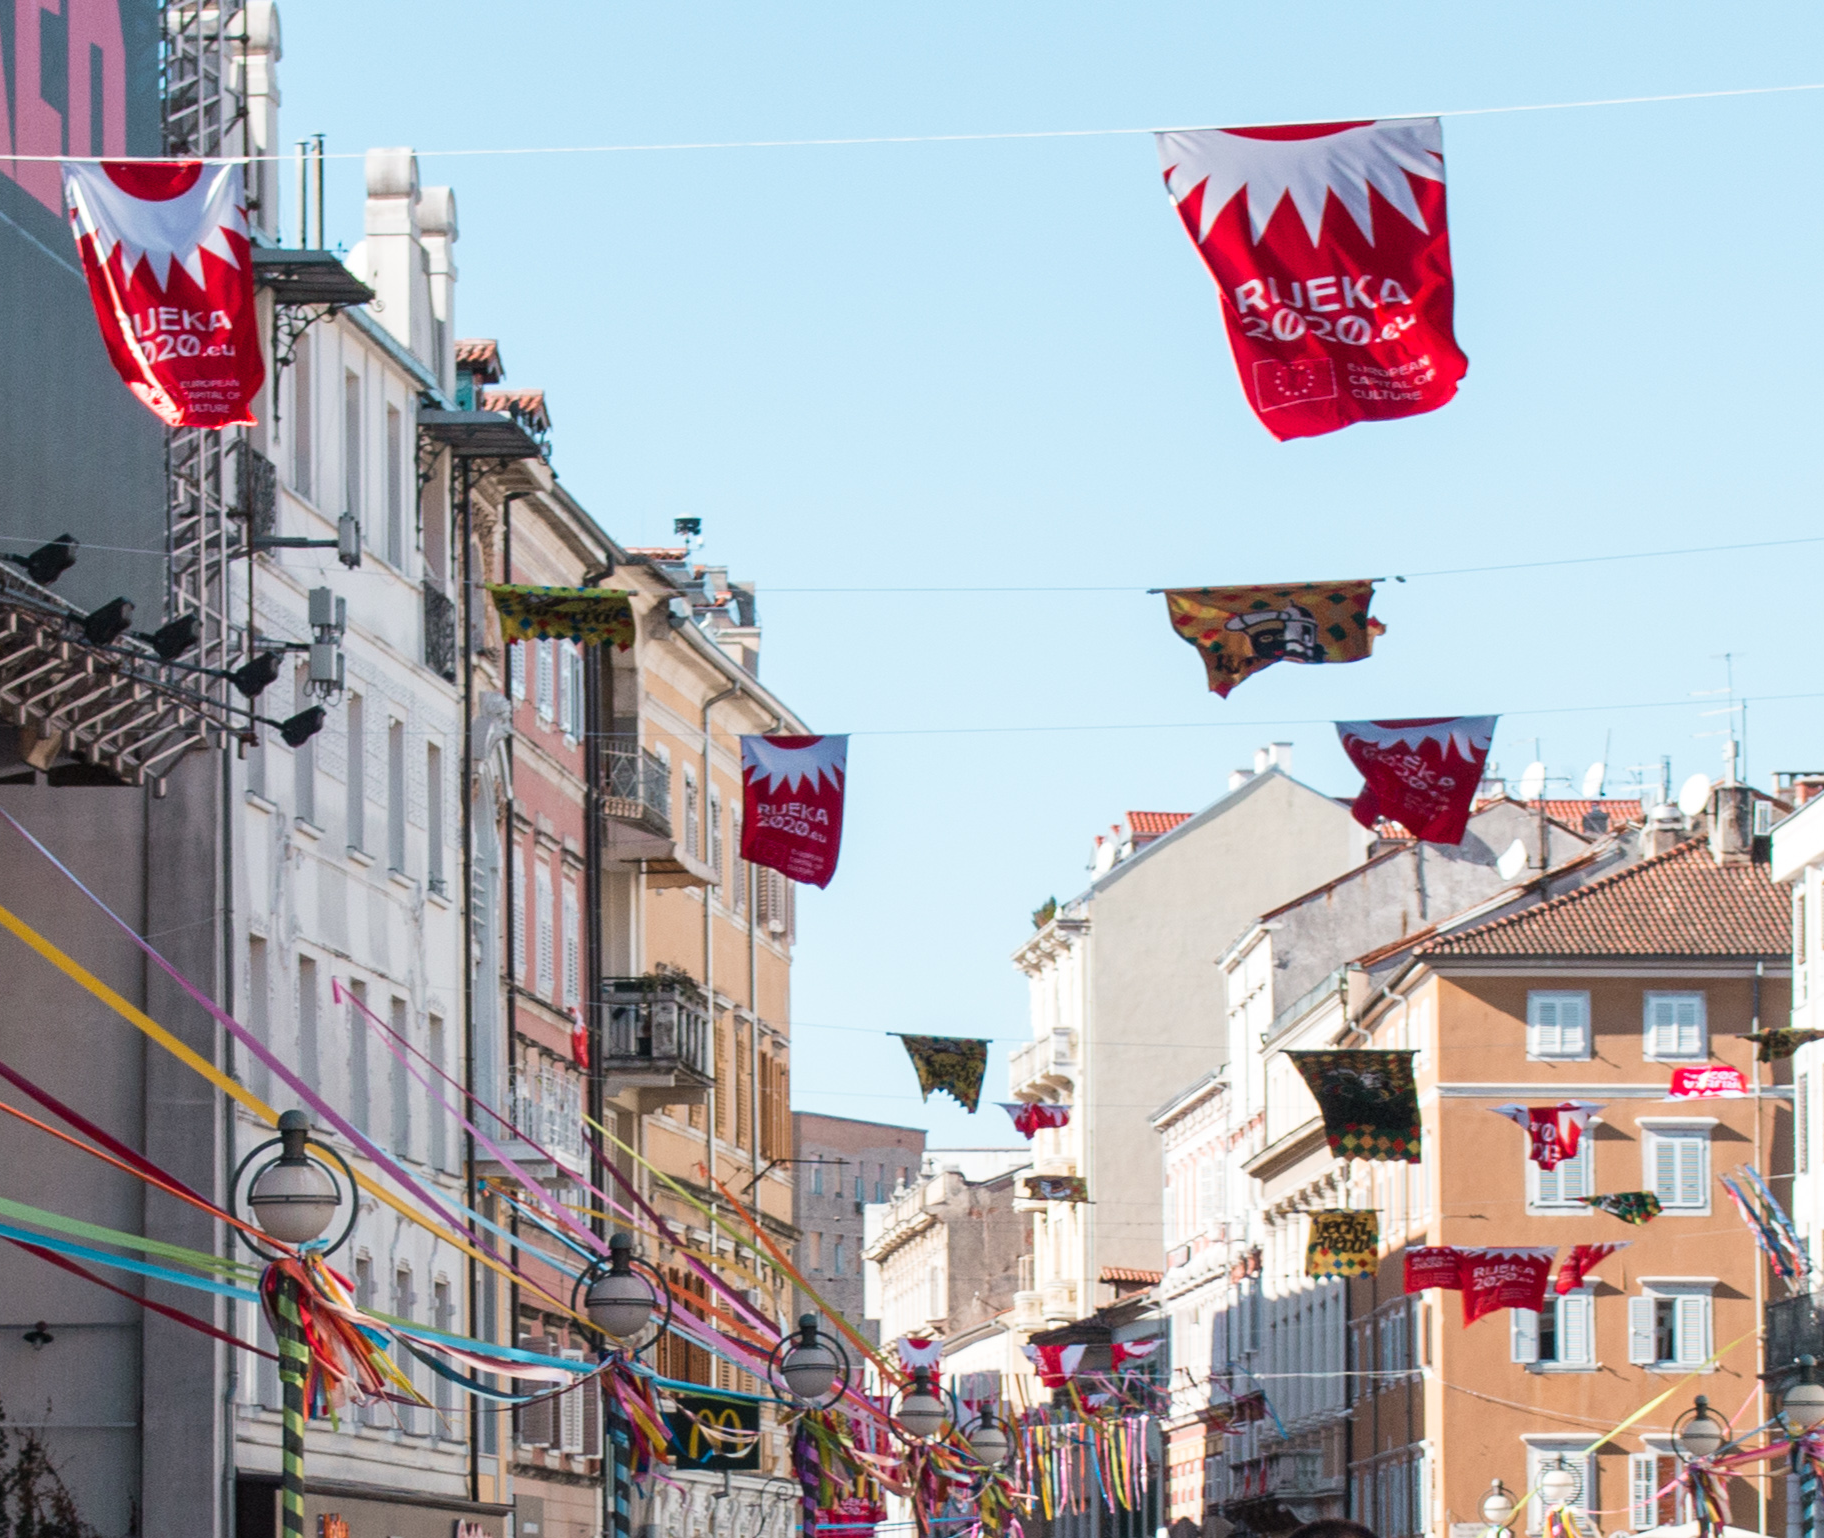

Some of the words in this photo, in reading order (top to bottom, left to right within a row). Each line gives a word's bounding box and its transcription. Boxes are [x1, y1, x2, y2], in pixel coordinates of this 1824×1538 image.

[1234, 275, 1413, 314] RIJEKA
[132, 306, 233, 338] IJEKA
[1242, 308, 1417, 345] 2020.eu
[1347, 354, 1430, 379] EUROPEAN
[1348, 375, 1413, 390] CAPITAL
[1414, 369, 1437, 385] OF
[1352, 388, 1423, 400] CULTURE
[189, 404, 230, 413] ULTURE
[757, 802, 829, 826] RIJEKA
[1472, 1263, 1536, 1279] RIJEKA
